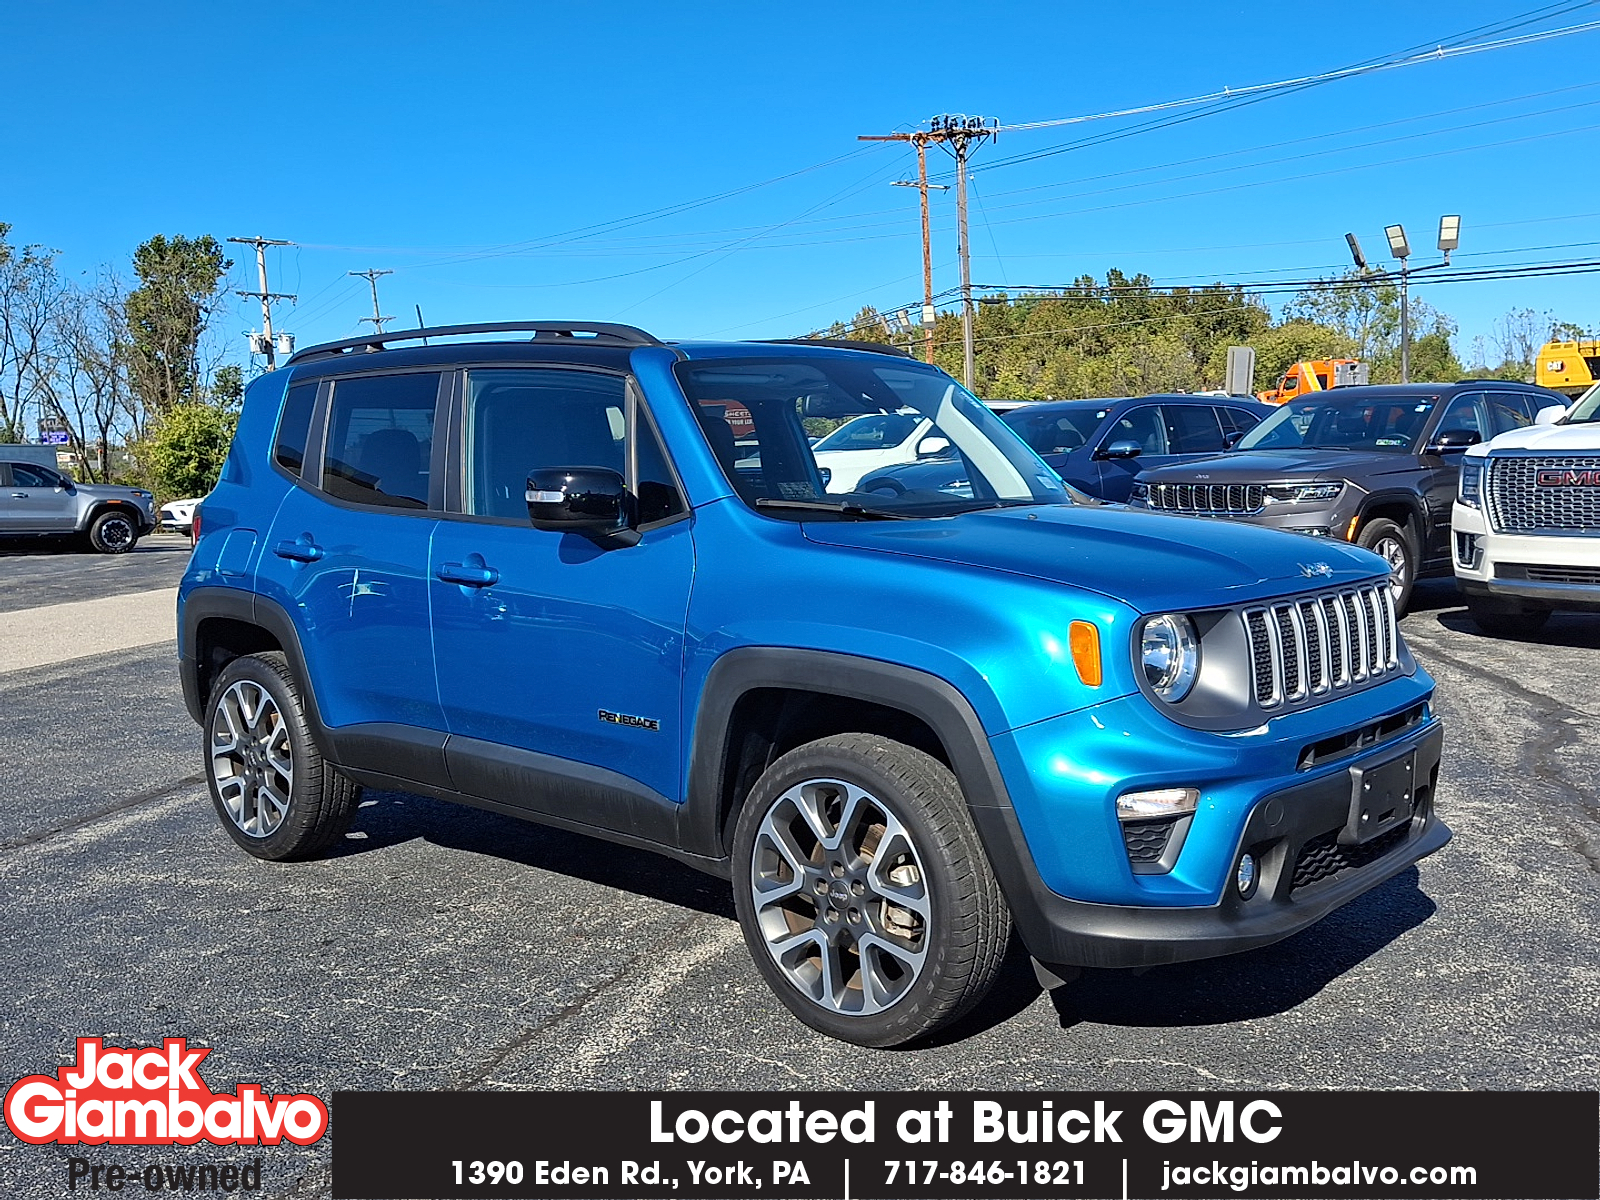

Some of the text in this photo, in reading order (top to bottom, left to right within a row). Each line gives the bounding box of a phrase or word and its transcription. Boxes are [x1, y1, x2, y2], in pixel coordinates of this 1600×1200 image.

[1547, 361, 1562, 371] CAT
[598, 708, 660, 732] RENEGADE
[830, 889, 848, 901] Jeep
